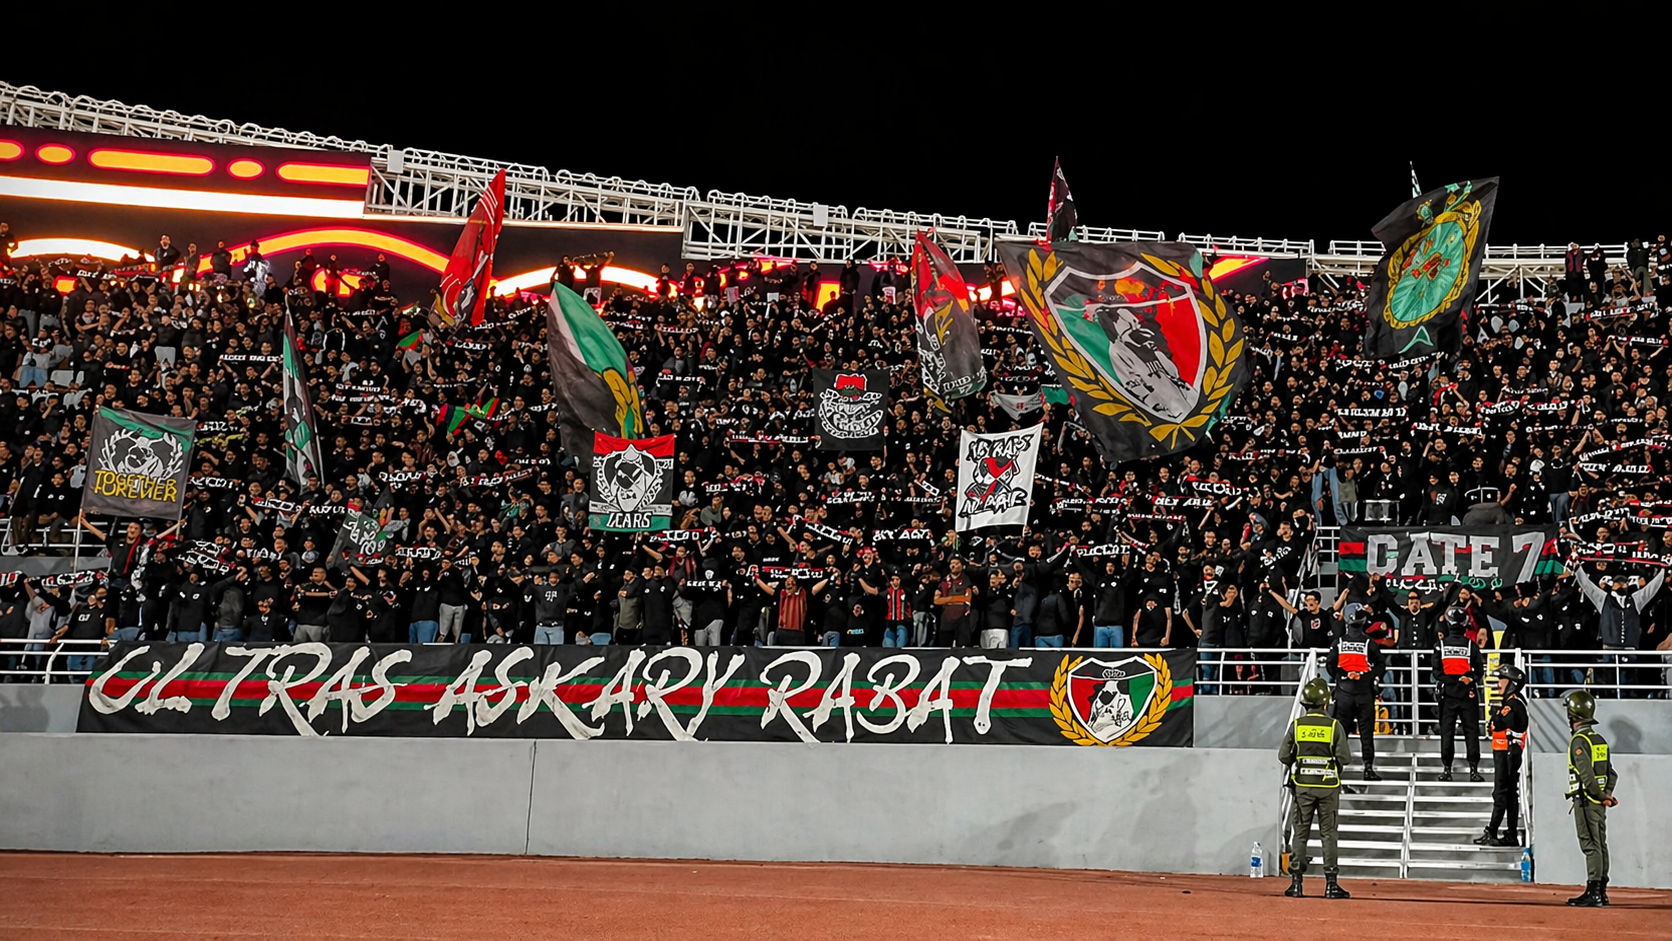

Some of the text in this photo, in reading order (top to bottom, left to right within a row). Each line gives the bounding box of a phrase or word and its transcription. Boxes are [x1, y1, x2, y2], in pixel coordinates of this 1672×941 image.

[1512, 531, 1545, 584] 7
[89, 642, 1033, 744] ULTRAS ASKARY RABAT
